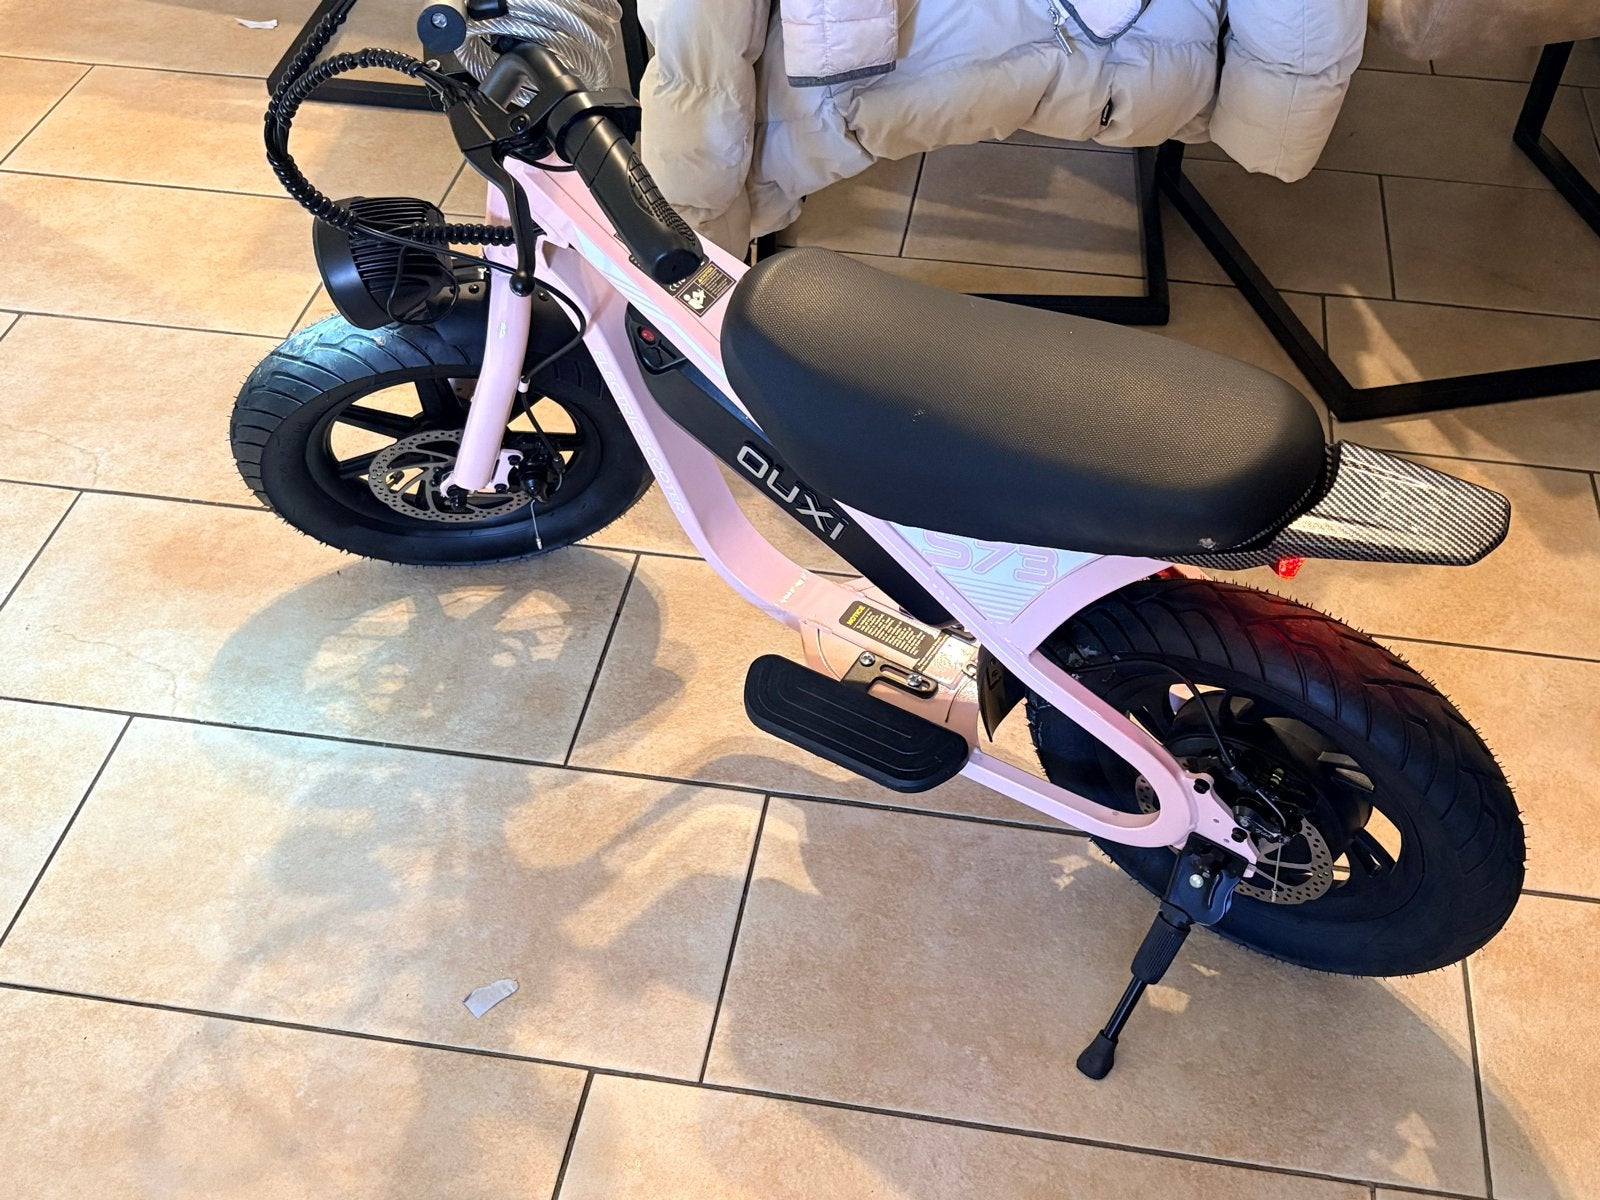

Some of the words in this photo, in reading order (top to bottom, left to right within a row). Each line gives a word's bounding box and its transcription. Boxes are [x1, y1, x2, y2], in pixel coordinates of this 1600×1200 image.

[593, 350, 645, 433] ELECTRIC
[638, 433, 686, 514] SCOOTER
[737, 445, 845, 541] OUXI
[847, 605, 865, 625] NOTICE
